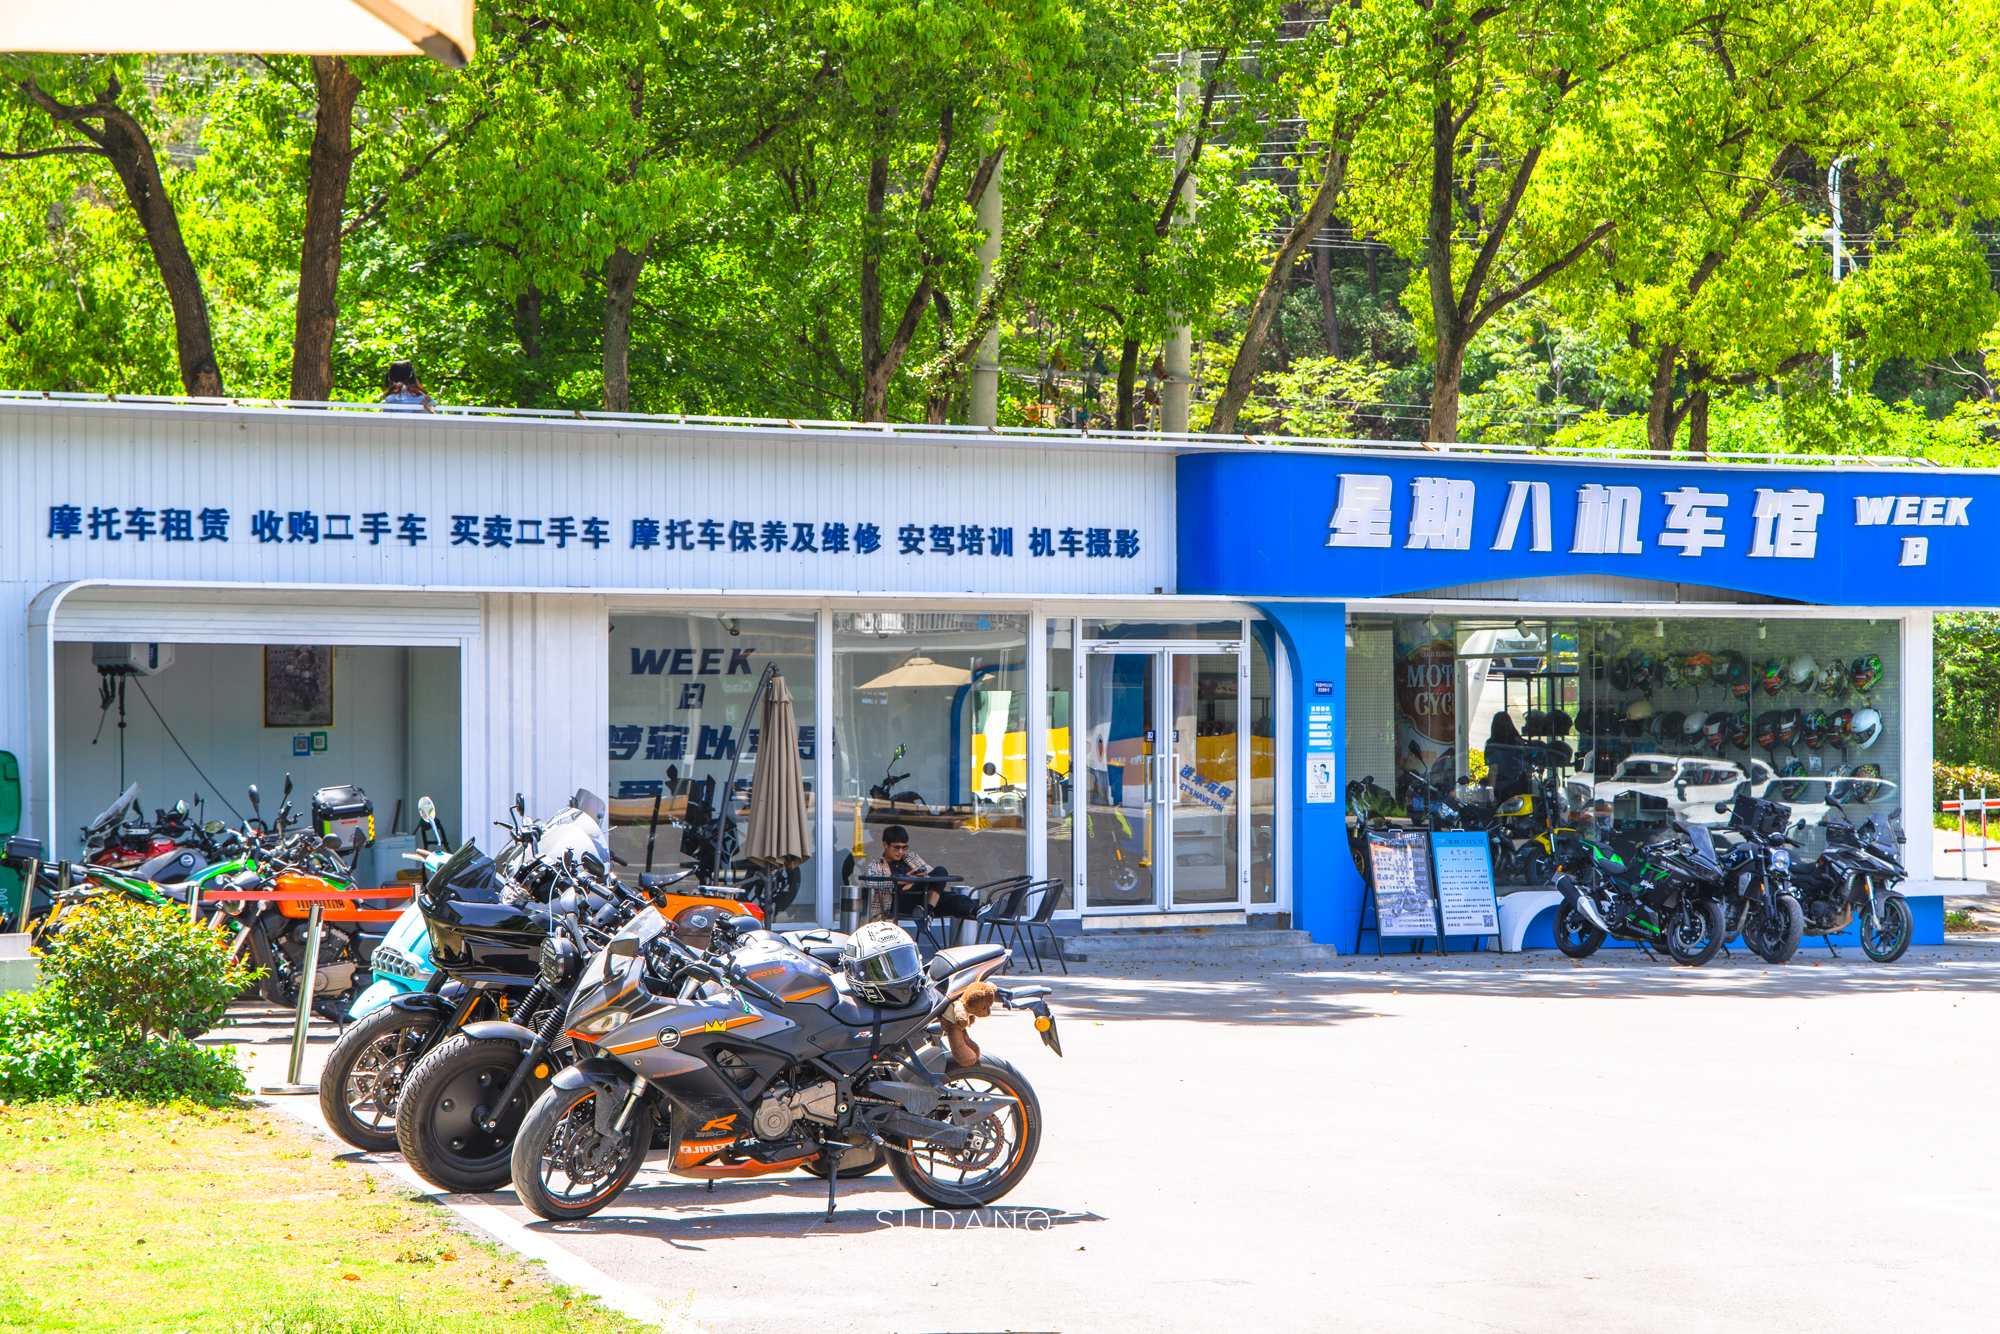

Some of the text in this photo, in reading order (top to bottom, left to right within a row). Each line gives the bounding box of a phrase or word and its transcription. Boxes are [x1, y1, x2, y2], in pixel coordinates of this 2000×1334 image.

[1325, 473, 1824, 558] 星期八机车馆
[1853, 496, 1973, 526] WEEK
[47, 504, 1141, 559] 摩托车租赁 收购二手车 买卖二手车 摩托车保养及维修 安驾培训 机车摄影
[630, 647, 756, 675] WEEK
[1407, 663, 1455, 687] MOT
[1179, 782, 1224, 812] ET'S HAVE FUN
[746, 966, 786, 979] JMOTOR
